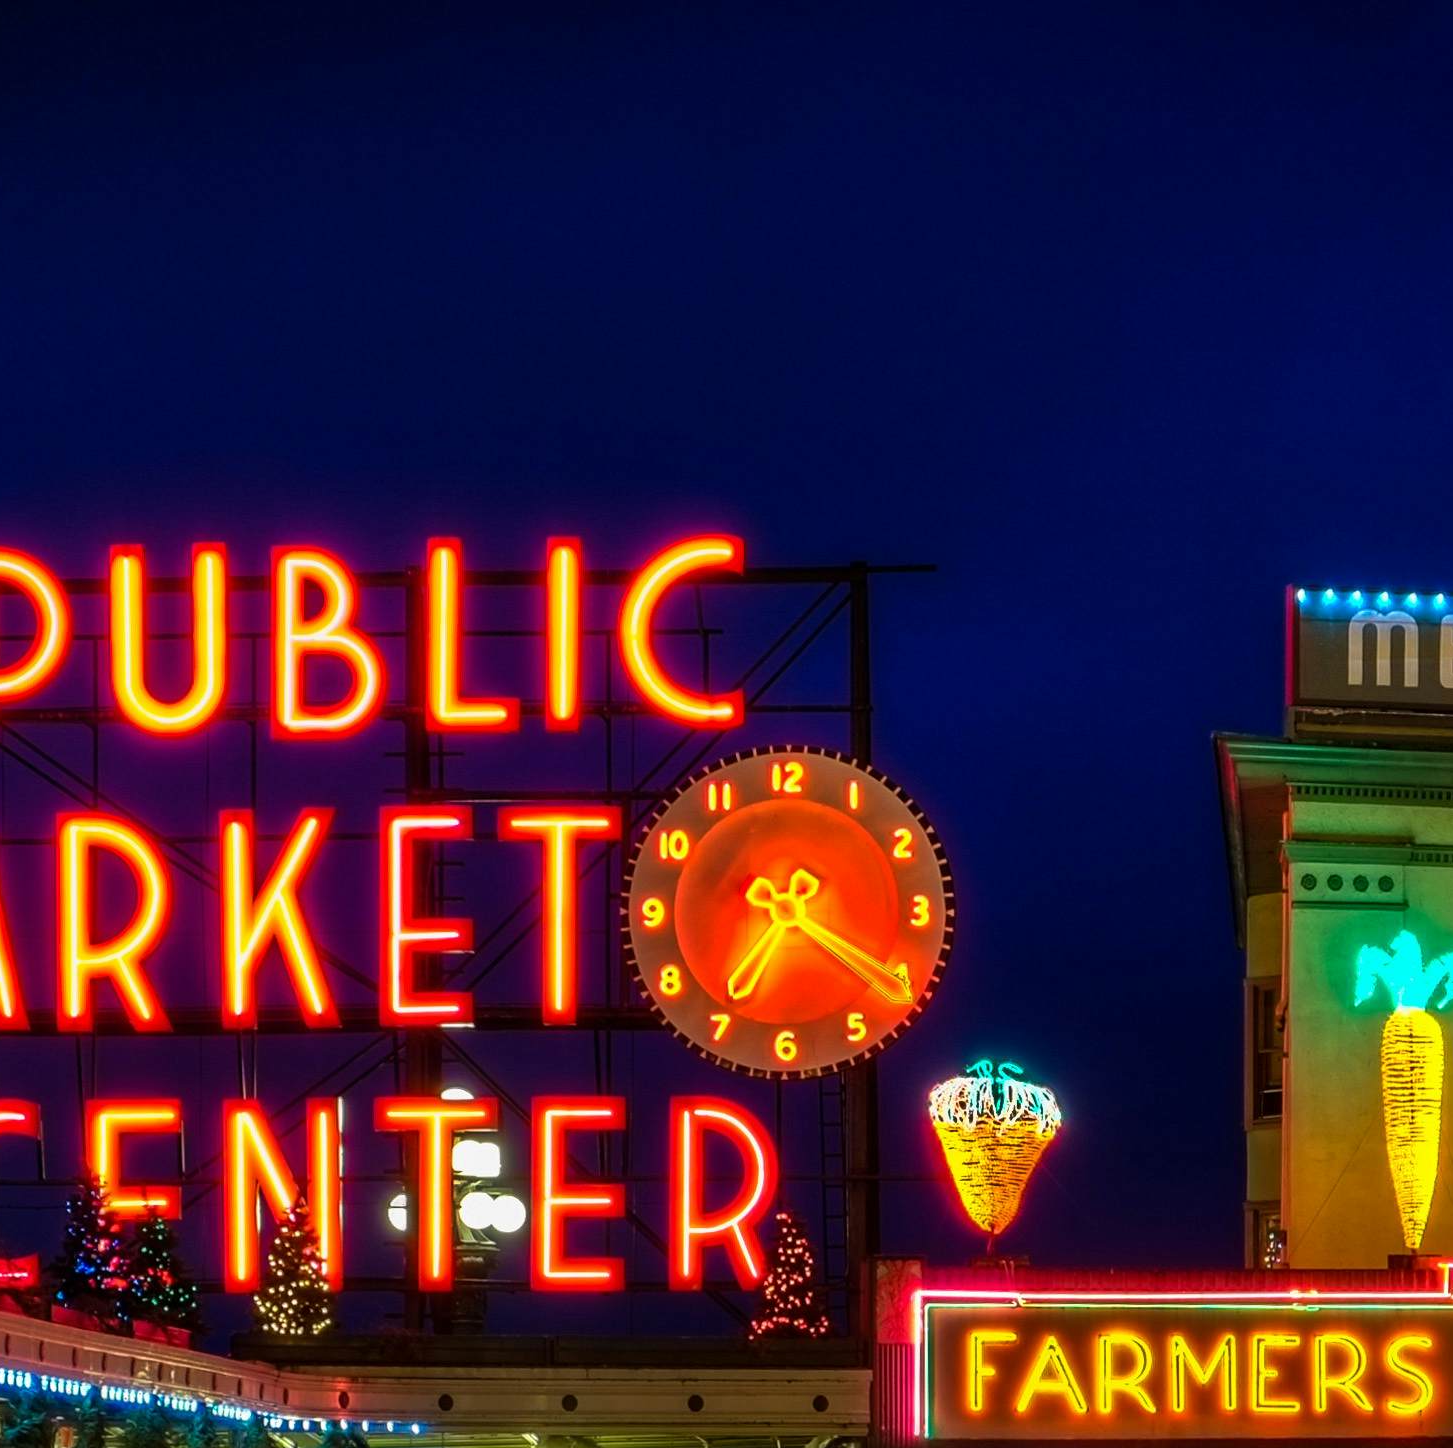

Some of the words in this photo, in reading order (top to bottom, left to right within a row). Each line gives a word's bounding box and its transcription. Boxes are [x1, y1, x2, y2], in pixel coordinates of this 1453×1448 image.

[771, 761, 804, 793] 12
[707, 783, 732, 811] 11
[849, 780, 859, 810] 1
[659, 829, 690, 860] 10
[892, 828, 913, 859] 2
[641, 897, 665, 927] 9
[910, 895, 931, 927] 3
[659, 964, 682, 996] 8
[710, 1013, 731, 1041] 7
[846, 1012, 867, 1042] 5
[774, 1030, 798, 1061] 6
[966, 1330, 1436, 1417] FARMERS
